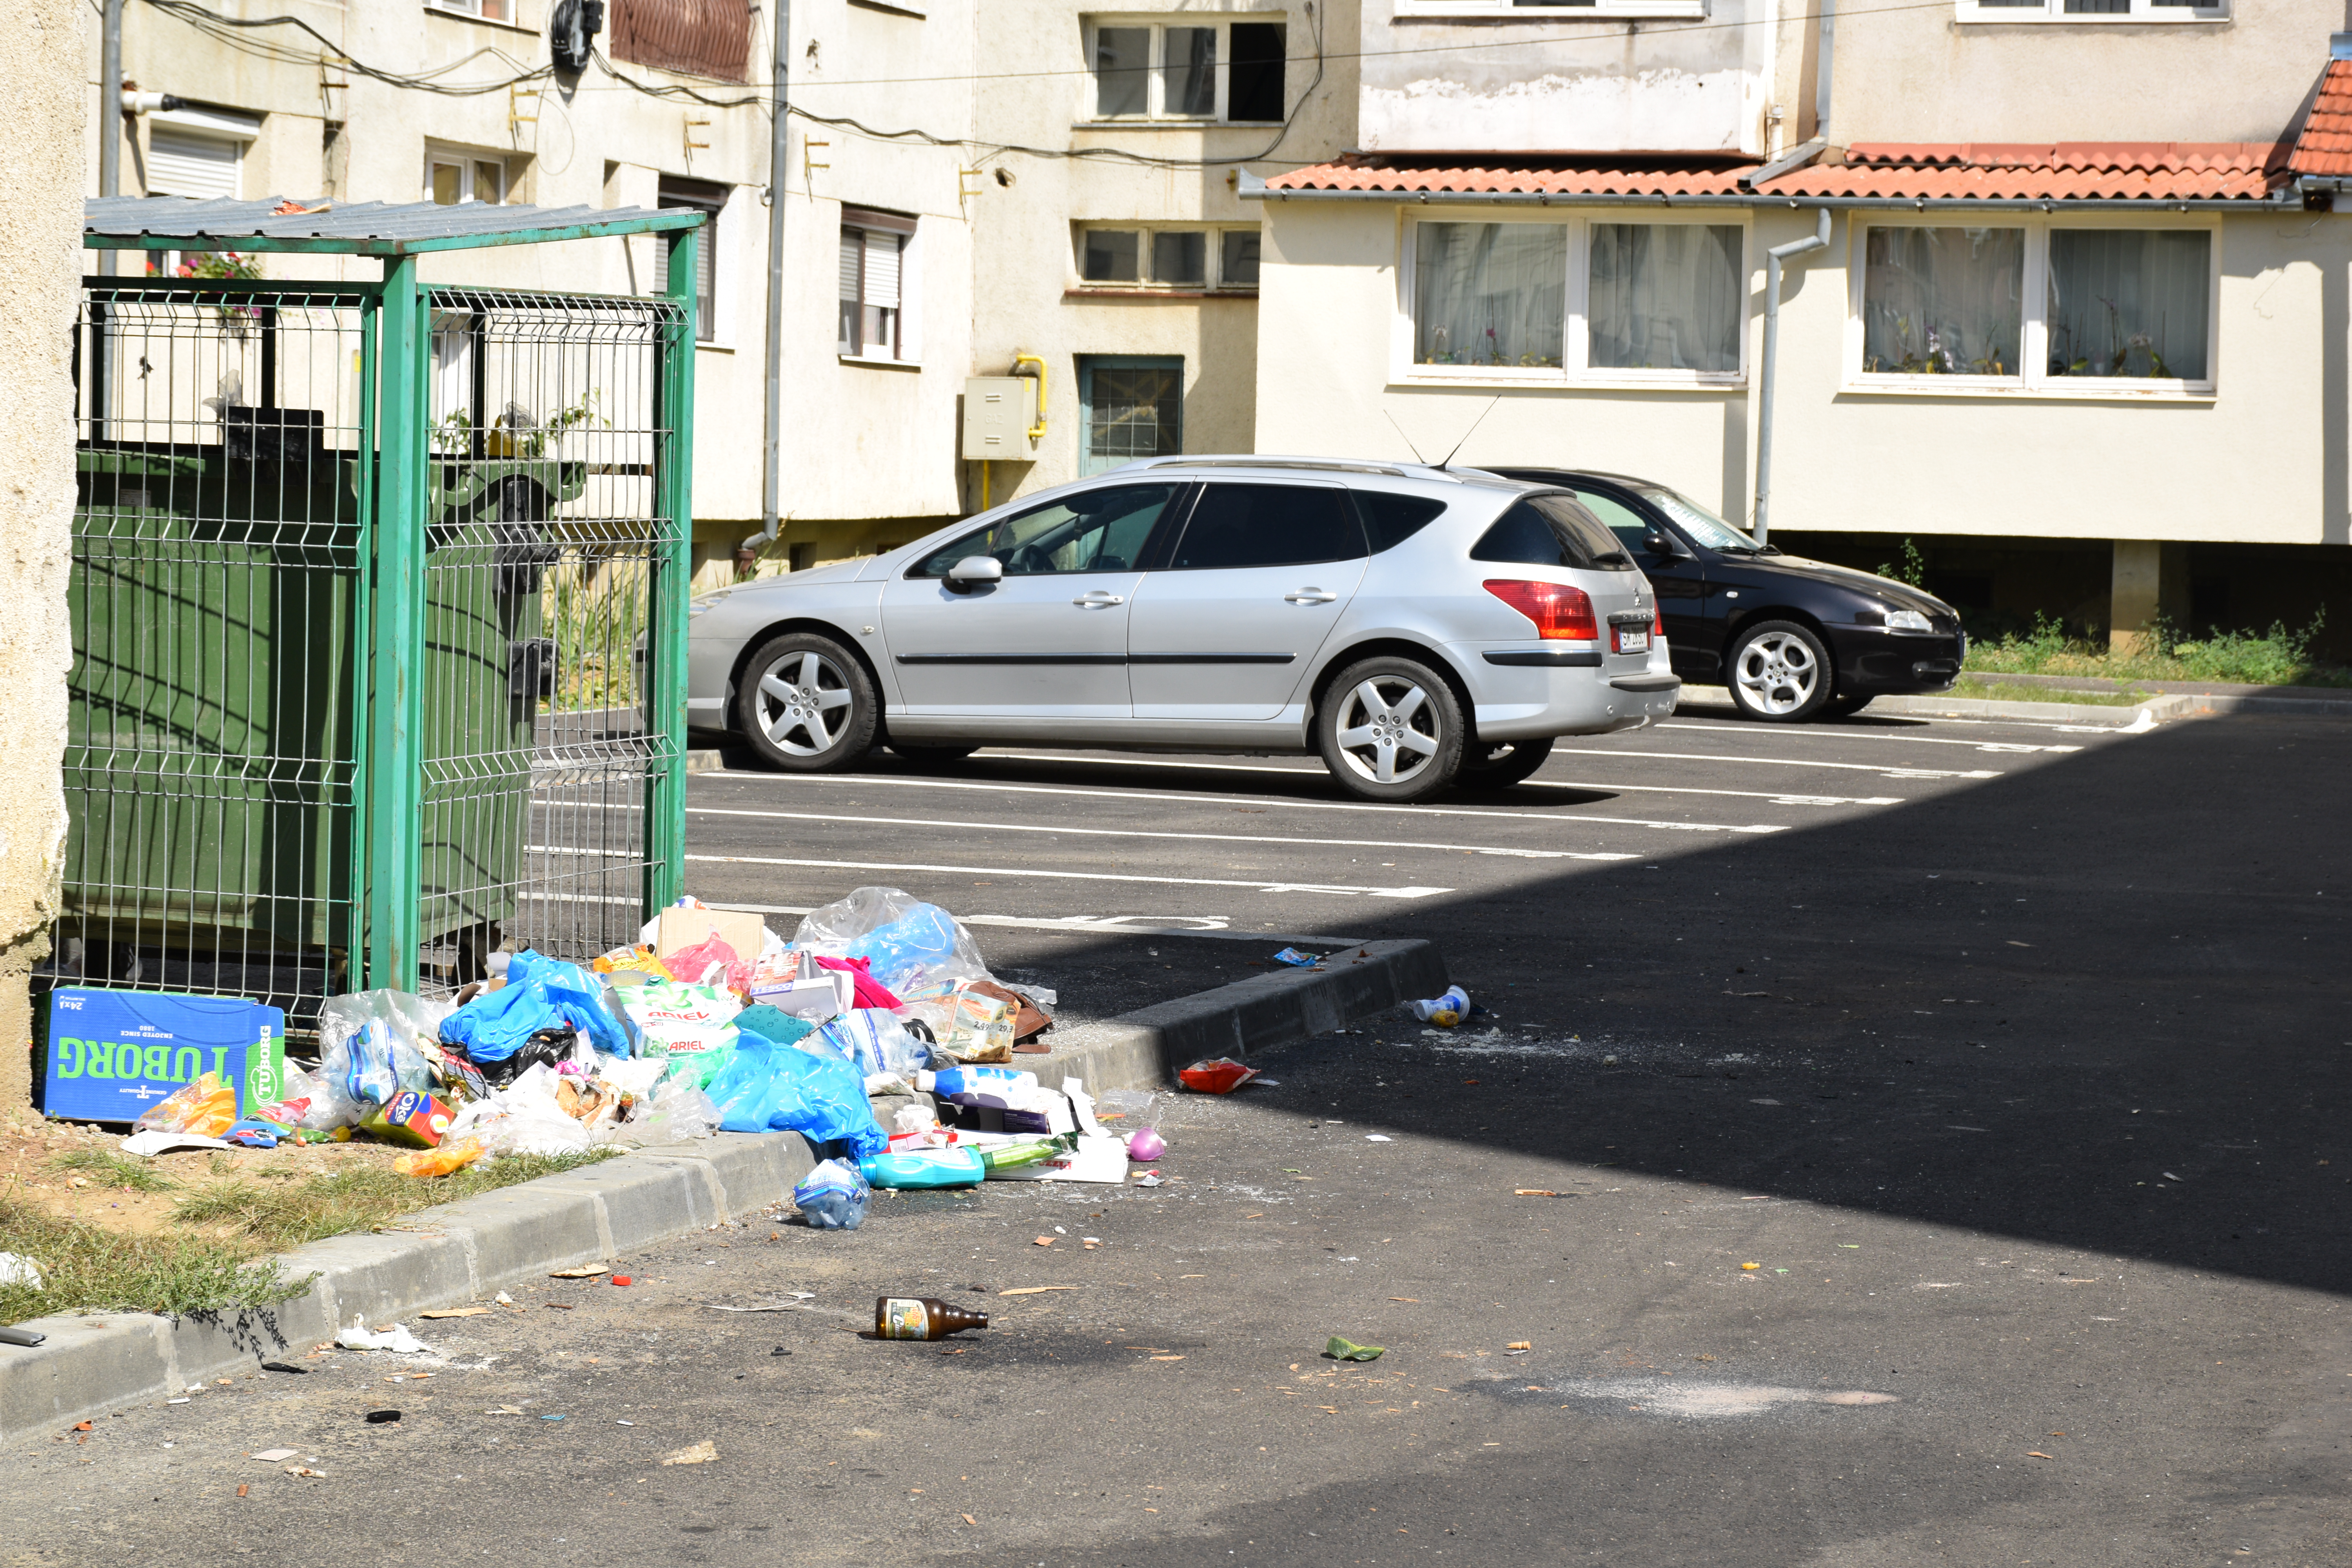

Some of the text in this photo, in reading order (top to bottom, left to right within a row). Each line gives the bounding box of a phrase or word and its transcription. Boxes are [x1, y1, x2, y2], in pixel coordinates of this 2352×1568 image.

[985, 414, 1004, 424] GAZ
[753, 983, 792, 992] TESCO
[974, 1021, 989, 1031] 2,49
[669, 1041, 705, 1051] ARIEL
[58, 1037, 234, 1088] TUBORG
[259, 1025, 271, 1095] TUBORG
